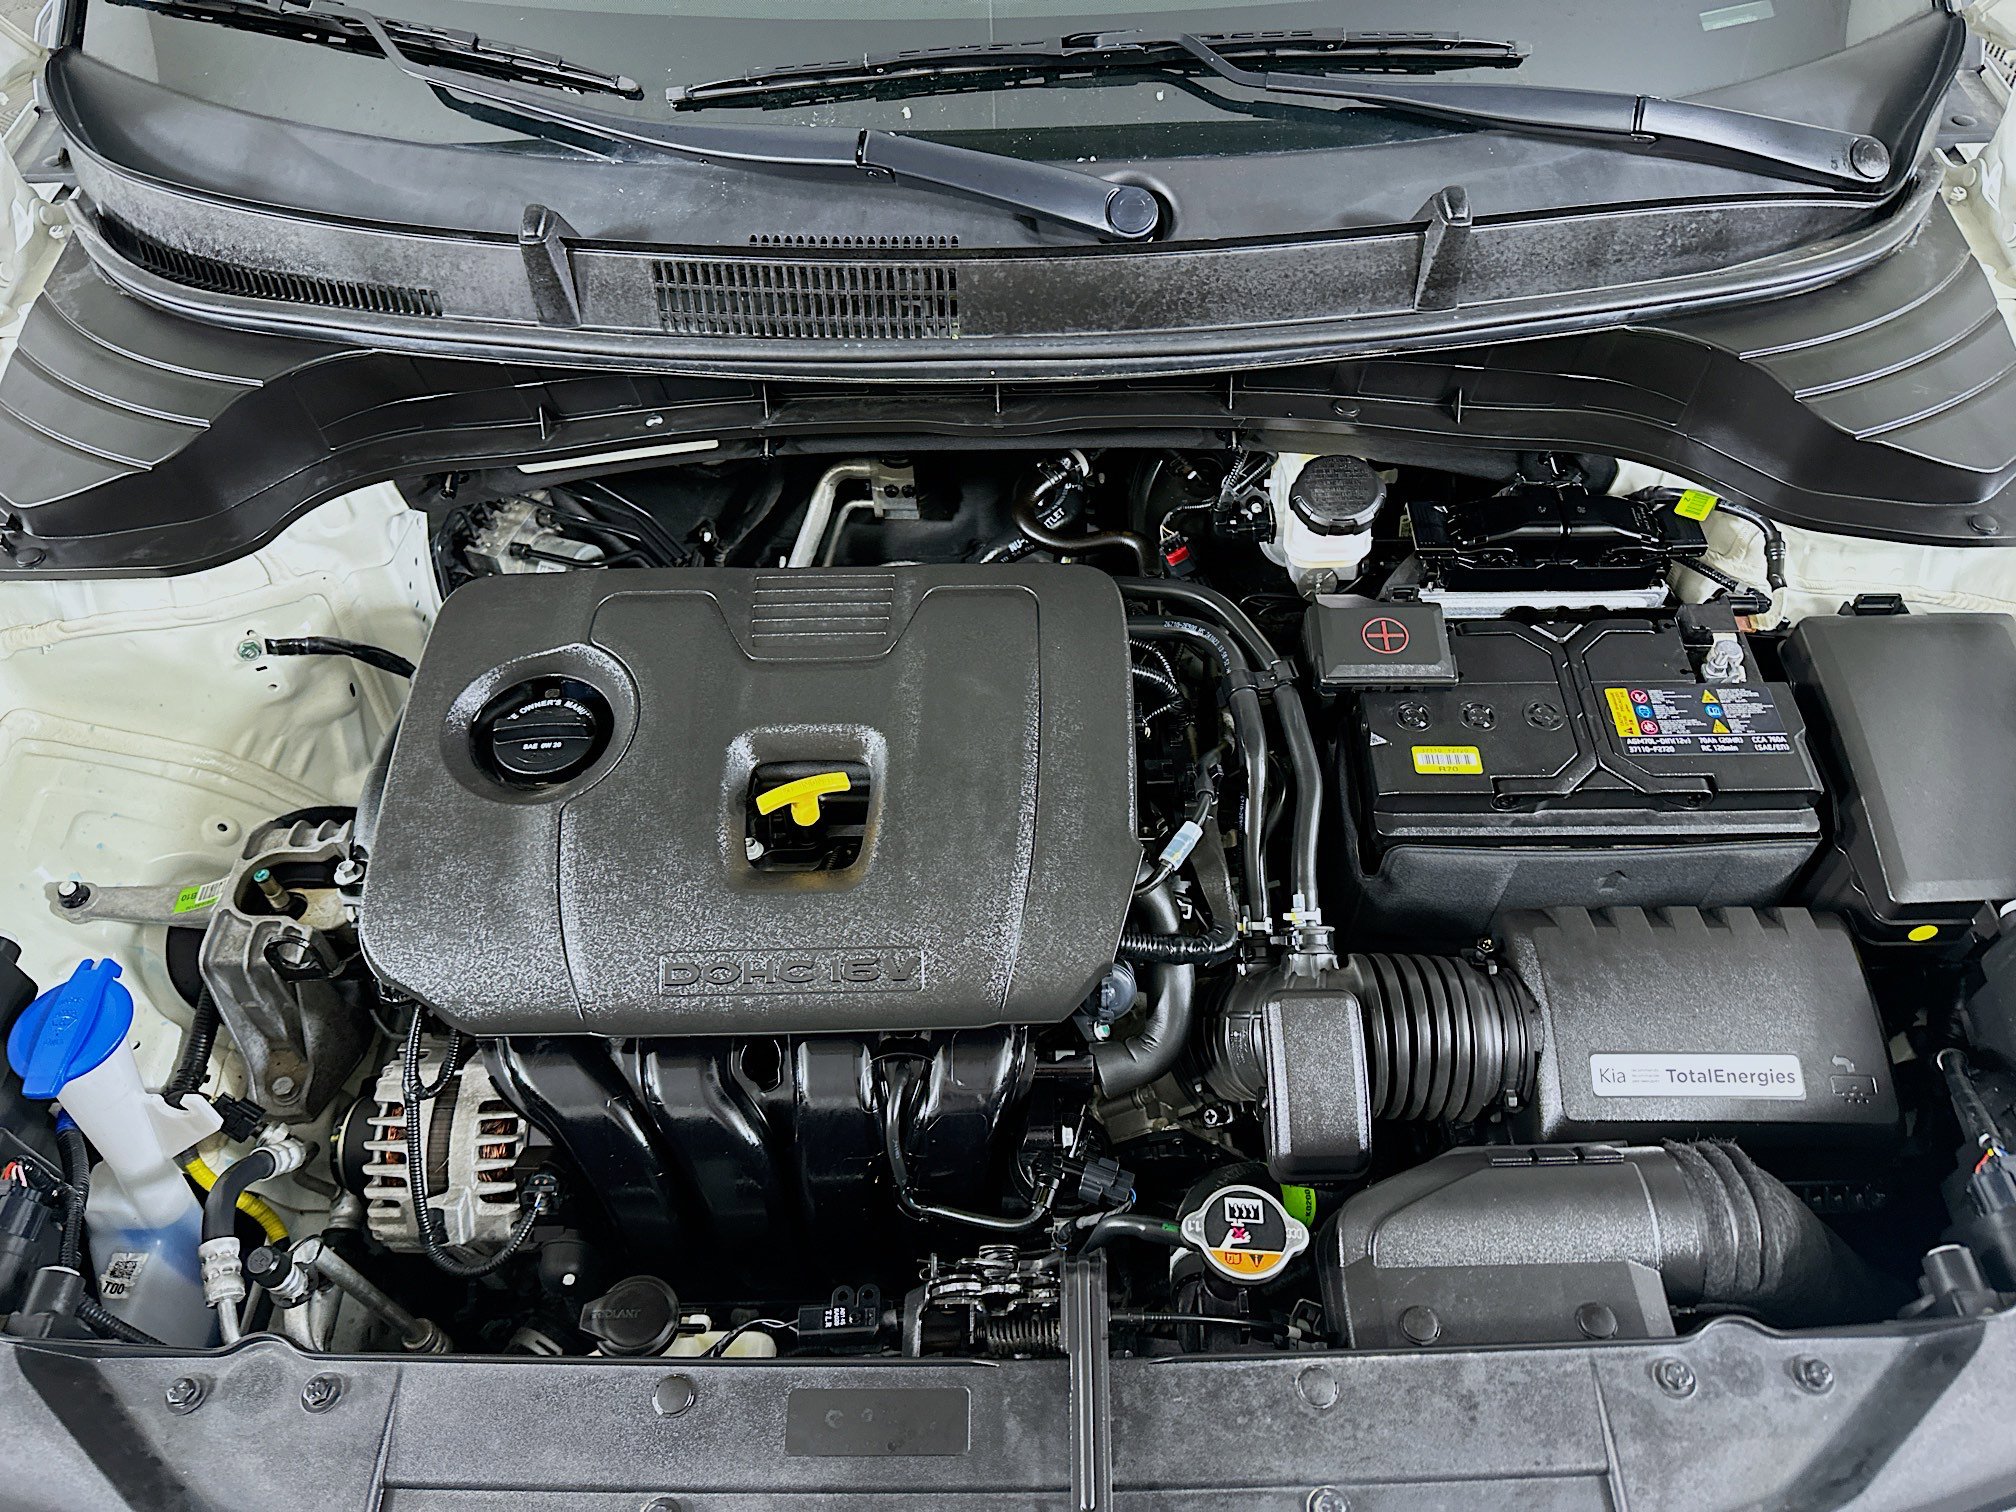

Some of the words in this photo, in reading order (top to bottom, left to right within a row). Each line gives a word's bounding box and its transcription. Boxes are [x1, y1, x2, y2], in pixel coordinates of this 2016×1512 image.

[519, 699, 562, 715] OWNER'S
[563, 700, 592, 719] MANU
[1701, 744, 1713, 752] RC
[1751, 736, 1768, 744] CCA
[663, 959, 815, 987] DOHC
[830, 955, 922, 983] 16V
[1599, 1067, 1626, 1084] Kia
[1665, 1068, 1796, 1087] TotalEnergies
